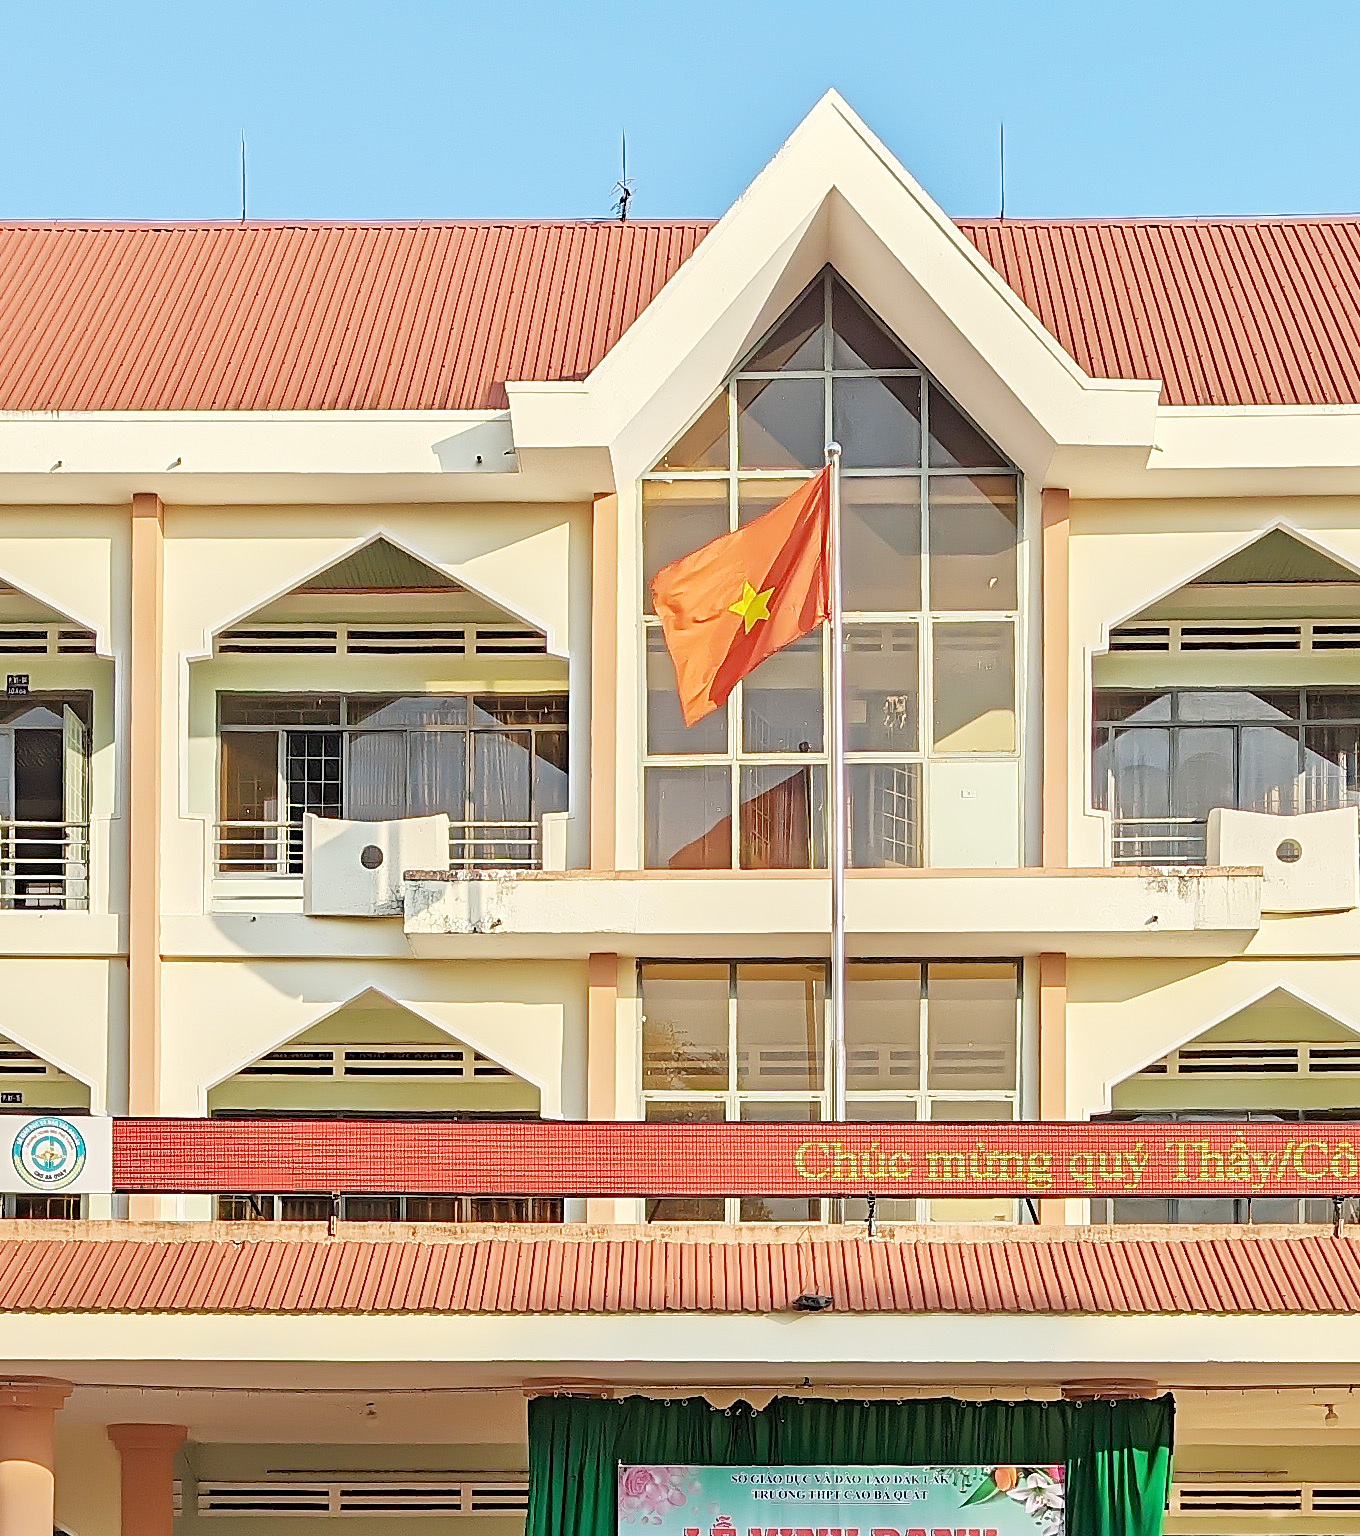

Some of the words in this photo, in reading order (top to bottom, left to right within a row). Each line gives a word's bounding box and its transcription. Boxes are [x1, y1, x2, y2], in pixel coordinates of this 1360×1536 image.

[794, 1141, 913, 1181] Chúc
[1068, 1141, 1151, 1192] quý
[808, 1490, 842, 1500] THPT
[843, 1490, 872, 1500] CAO
[874, 1487, 891, 1500] BÁ
